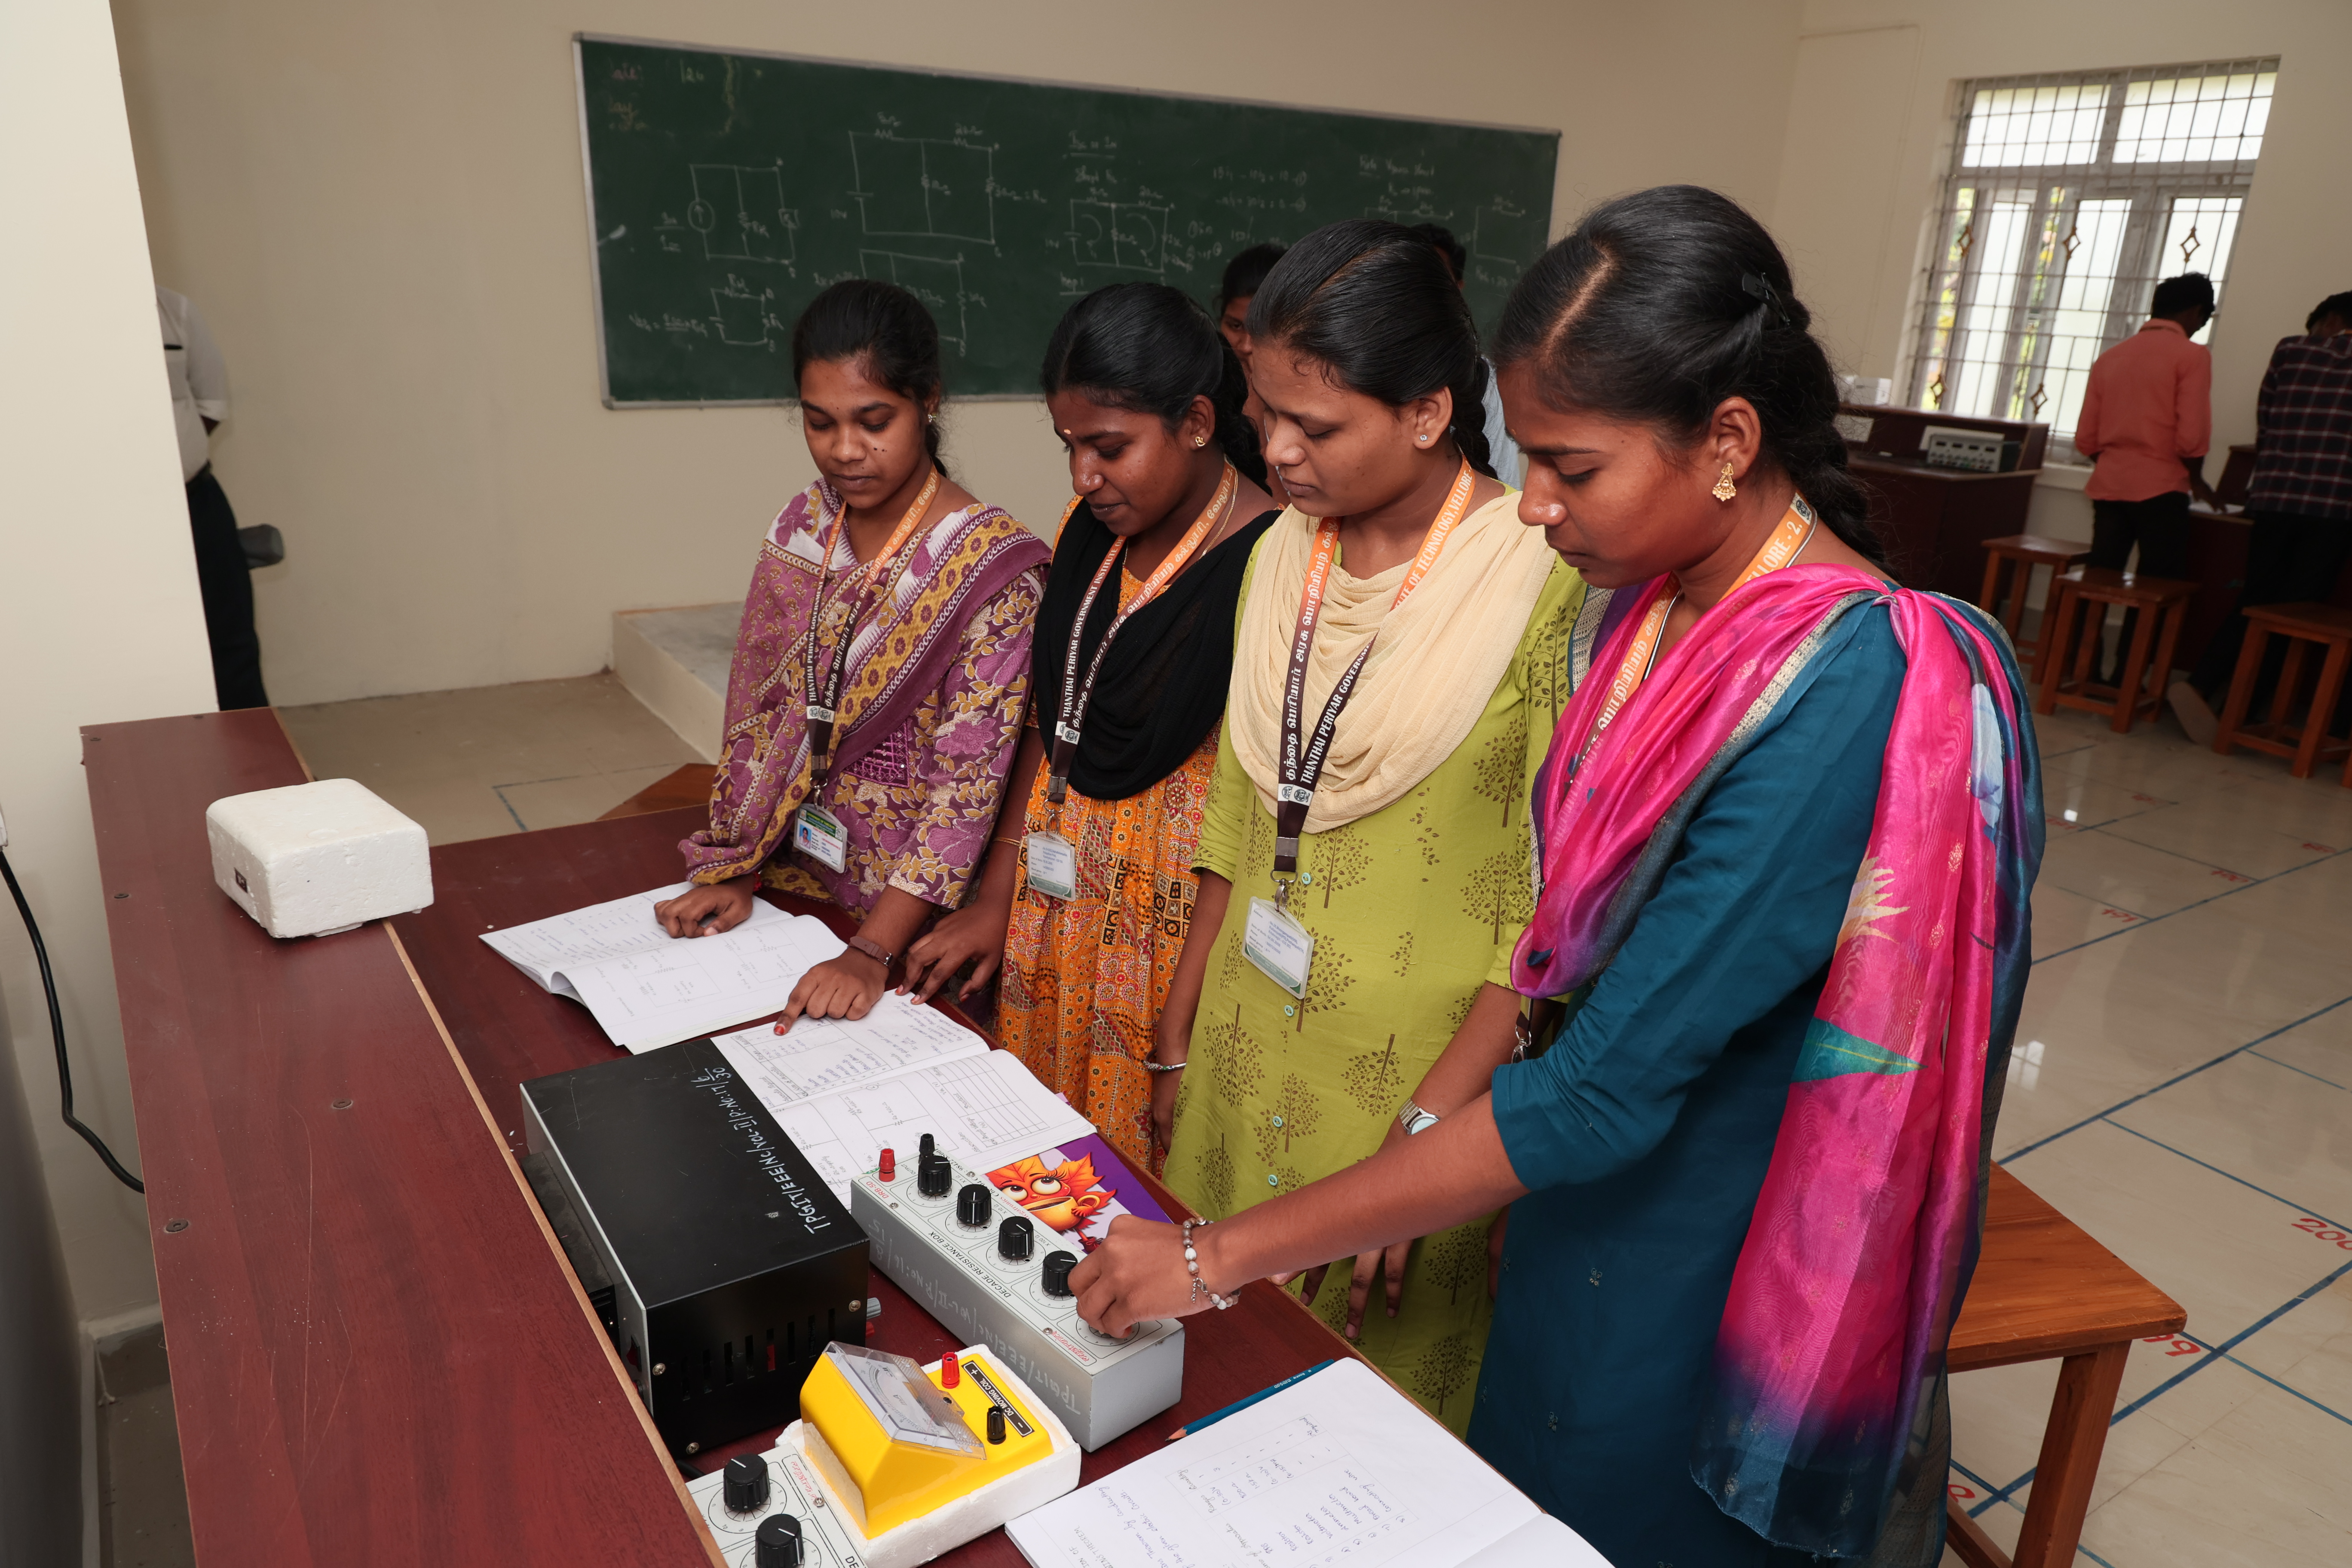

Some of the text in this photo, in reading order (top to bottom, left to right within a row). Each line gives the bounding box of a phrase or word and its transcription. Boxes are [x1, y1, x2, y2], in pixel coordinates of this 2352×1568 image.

[1094, 548, 1118, 584] INSTITUTE
[1408, 570, 1422, 586] OF
[811, 582, 823, 629] GOVERNMENT
[1073, 586, 1097, 637] GOVERNMENT
[1067, 640, 1078, 675] PERIYAR
[807, 666, 817, 702] THANTHAI
[1063, 677, 1074, 717] THANTHAI
[1300, 737, 1326, 784] THANTHAI
[1318, 694, 1343, 737] PERIYAR
[866, 1179, 889, 1200] DRB-5D
[927, 1229, 1011, 1299] DECADE RESISTANCE BOX
[979, 1377, 1014, 1417] DC MOVING COIL
[1274, 1378, 1291, 1388] apsara
